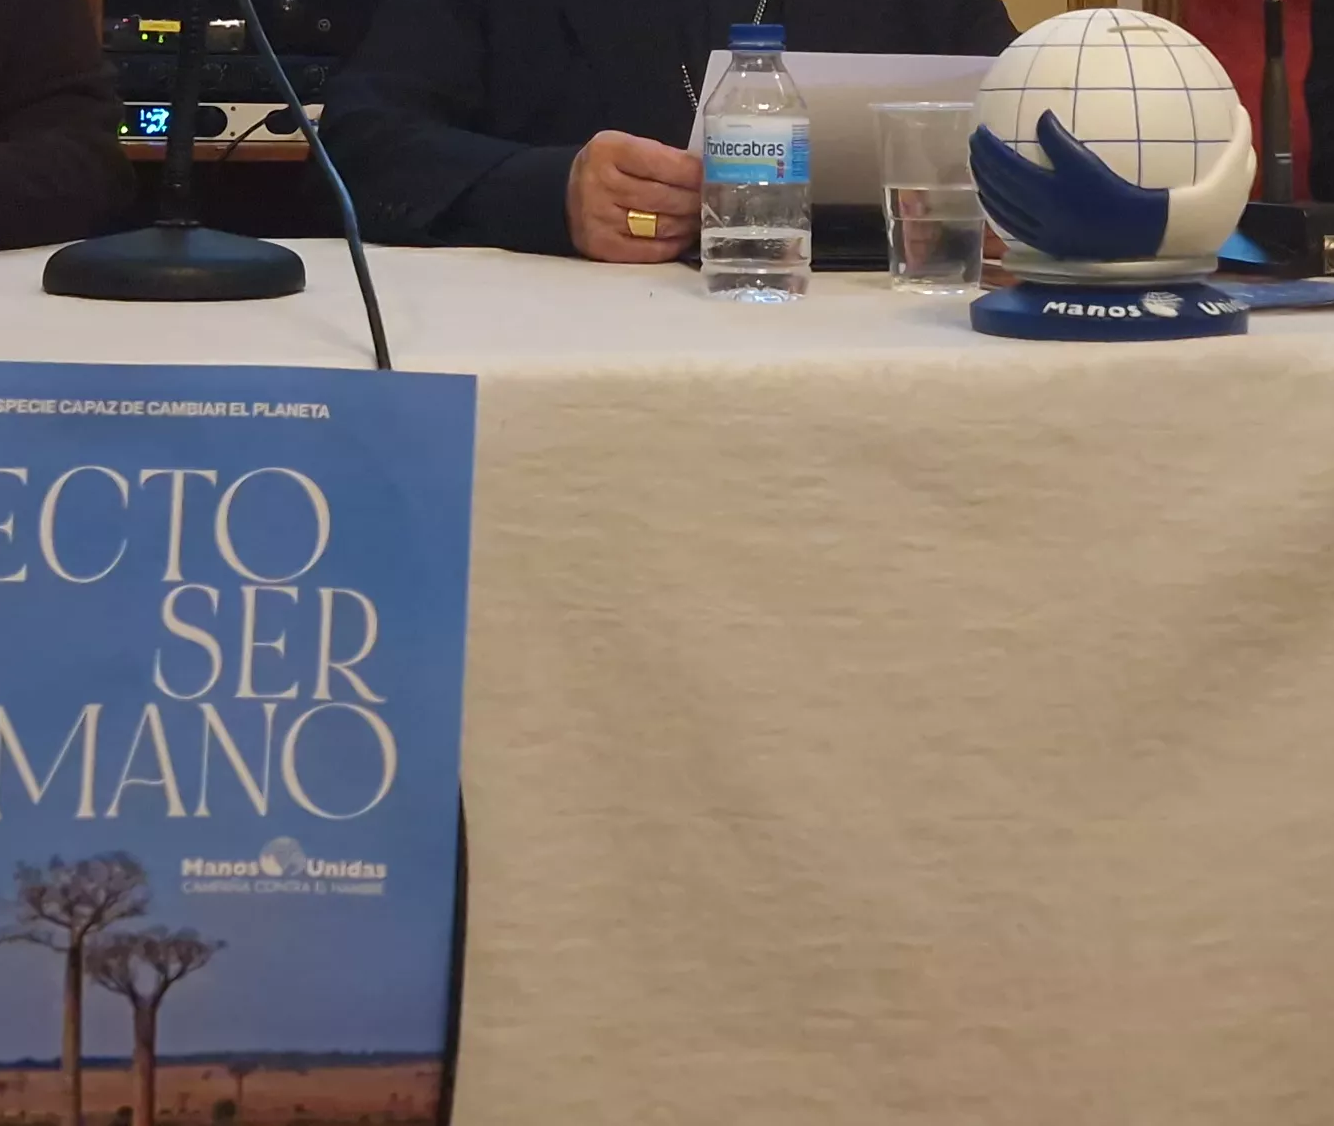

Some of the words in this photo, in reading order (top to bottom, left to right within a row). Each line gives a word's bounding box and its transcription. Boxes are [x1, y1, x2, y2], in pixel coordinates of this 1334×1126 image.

[1042, 300, 1142, 318] Manos
[60, 399, 117, 415] CAPAZ
[121, 400, 144, 415] DE
[147, 400, 226, 416] CAMBIAR
[229, 401, 249, 417] EL
[252, 402, 330, 418] PLANETA
[152, 583, 387, 703] SER
[181, 858, 259, 877] Manos
[306, 858, 387, 878] Unidas
